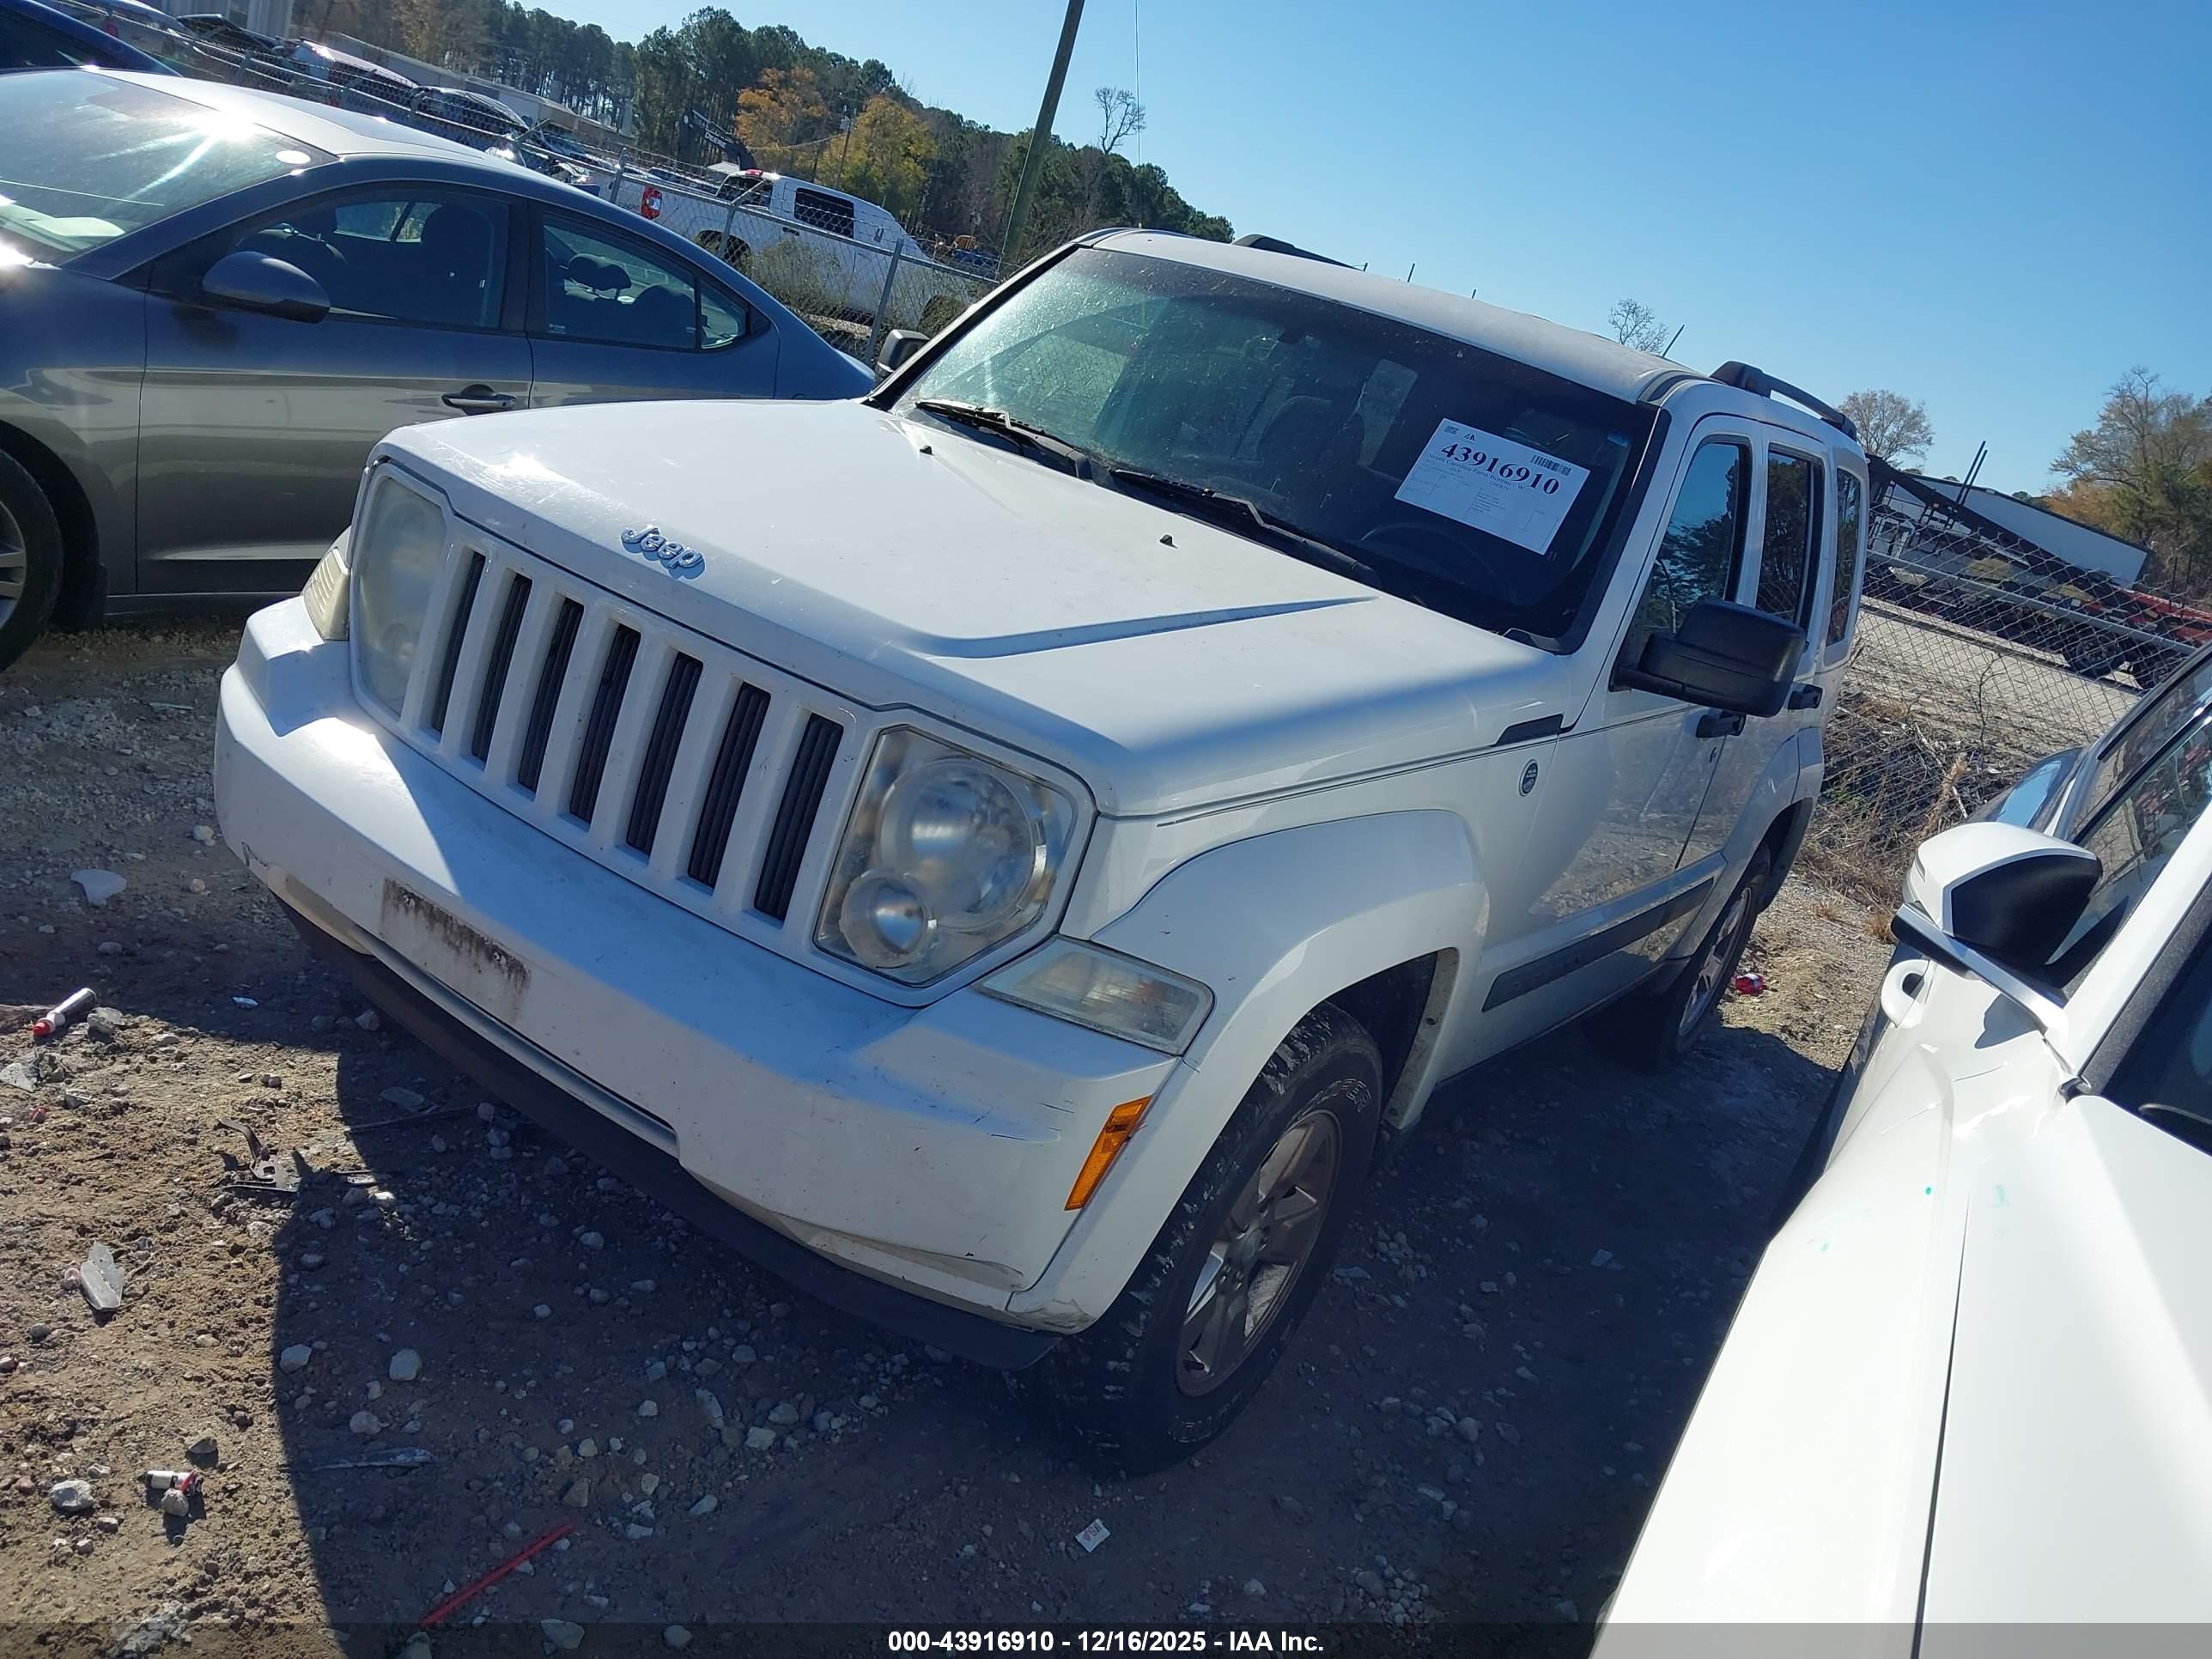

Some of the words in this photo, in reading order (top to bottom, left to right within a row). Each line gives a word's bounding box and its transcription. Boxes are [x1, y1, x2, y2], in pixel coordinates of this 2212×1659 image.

[704, 131, 727, 149] DEERE
[1441, 443, 1559, 495] 43916910
[621, 525, 705, 580] Jeep
